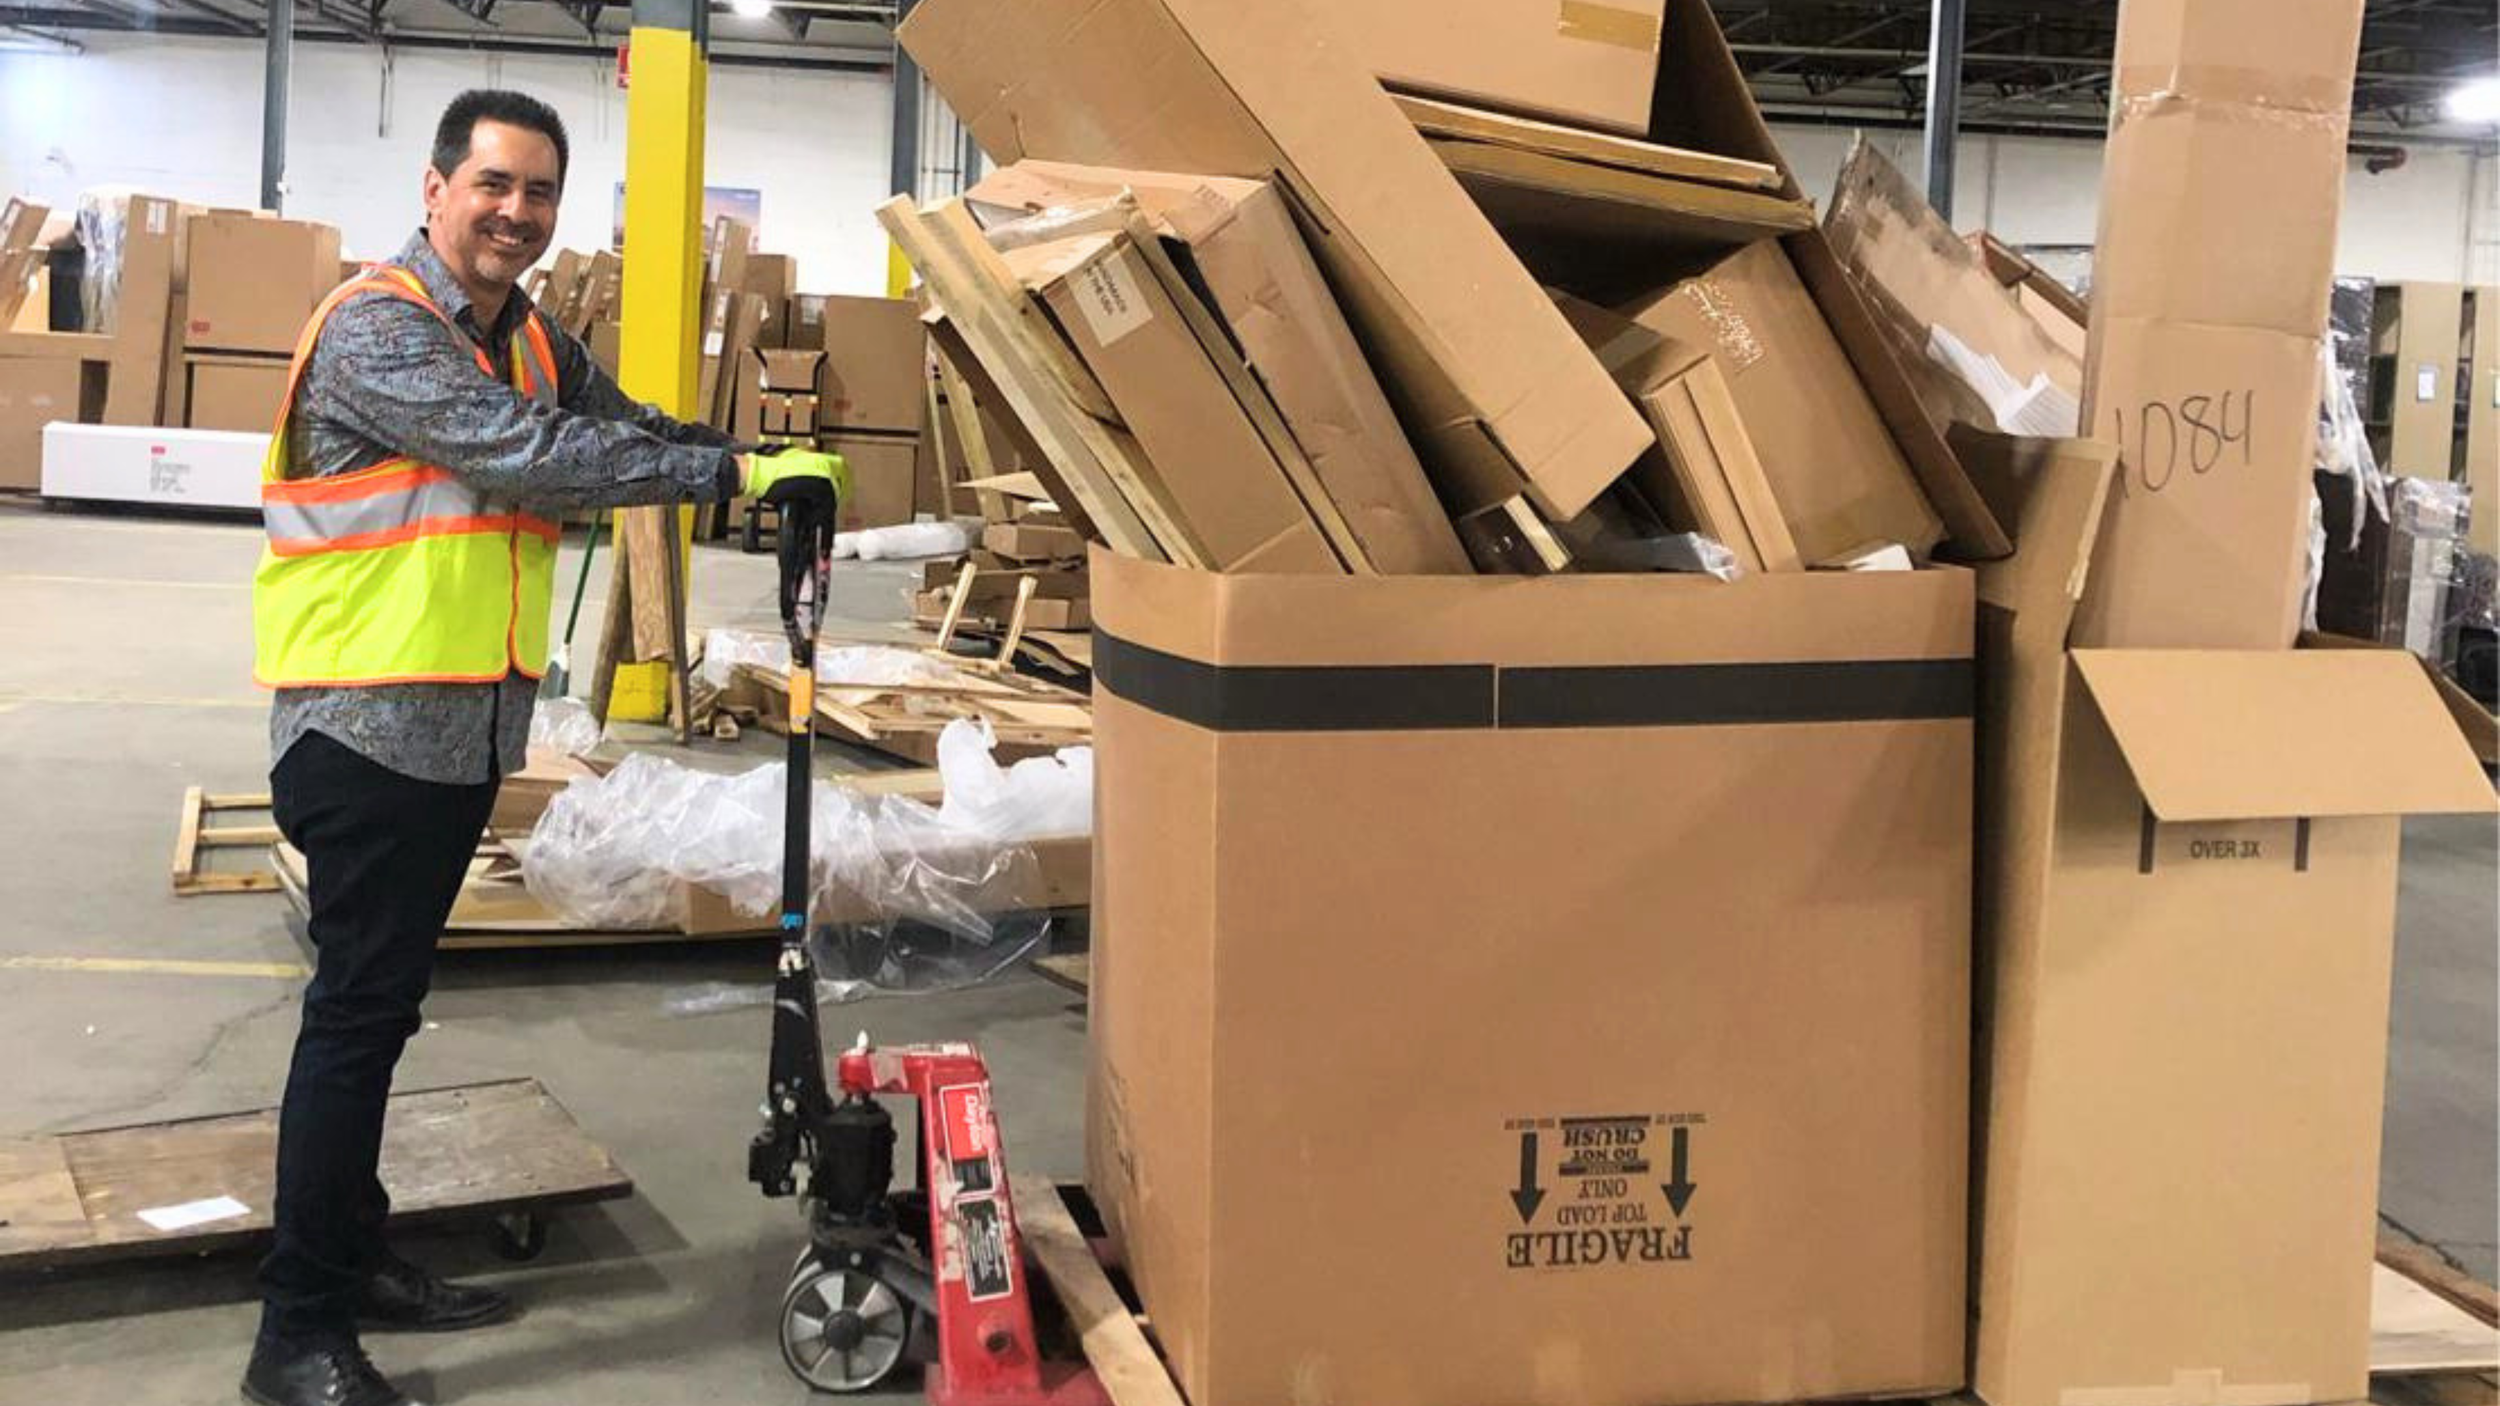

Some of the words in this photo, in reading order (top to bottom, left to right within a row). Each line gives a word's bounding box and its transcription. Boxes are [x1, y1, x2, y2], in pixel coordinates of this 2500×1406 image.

[2116, 389, 2254, 499] 1084
[2190, 840, 2237, 859] OVER
[964, 1094, 983, 1151] Dayton
[1564, 1128, 1646, 1147] CRUSH
[1572, 1149, 1609, 1162] NOT
[1613, 1148, 1639, 1161] DO
[1577, 1177, 1628, 1199] ONLY
[1557, 1205, 1608, 1225] LOAD
[1612, 1203, 1648, 1223] TOP
[1507, 1226, 1693, 1267] FRAGILE
